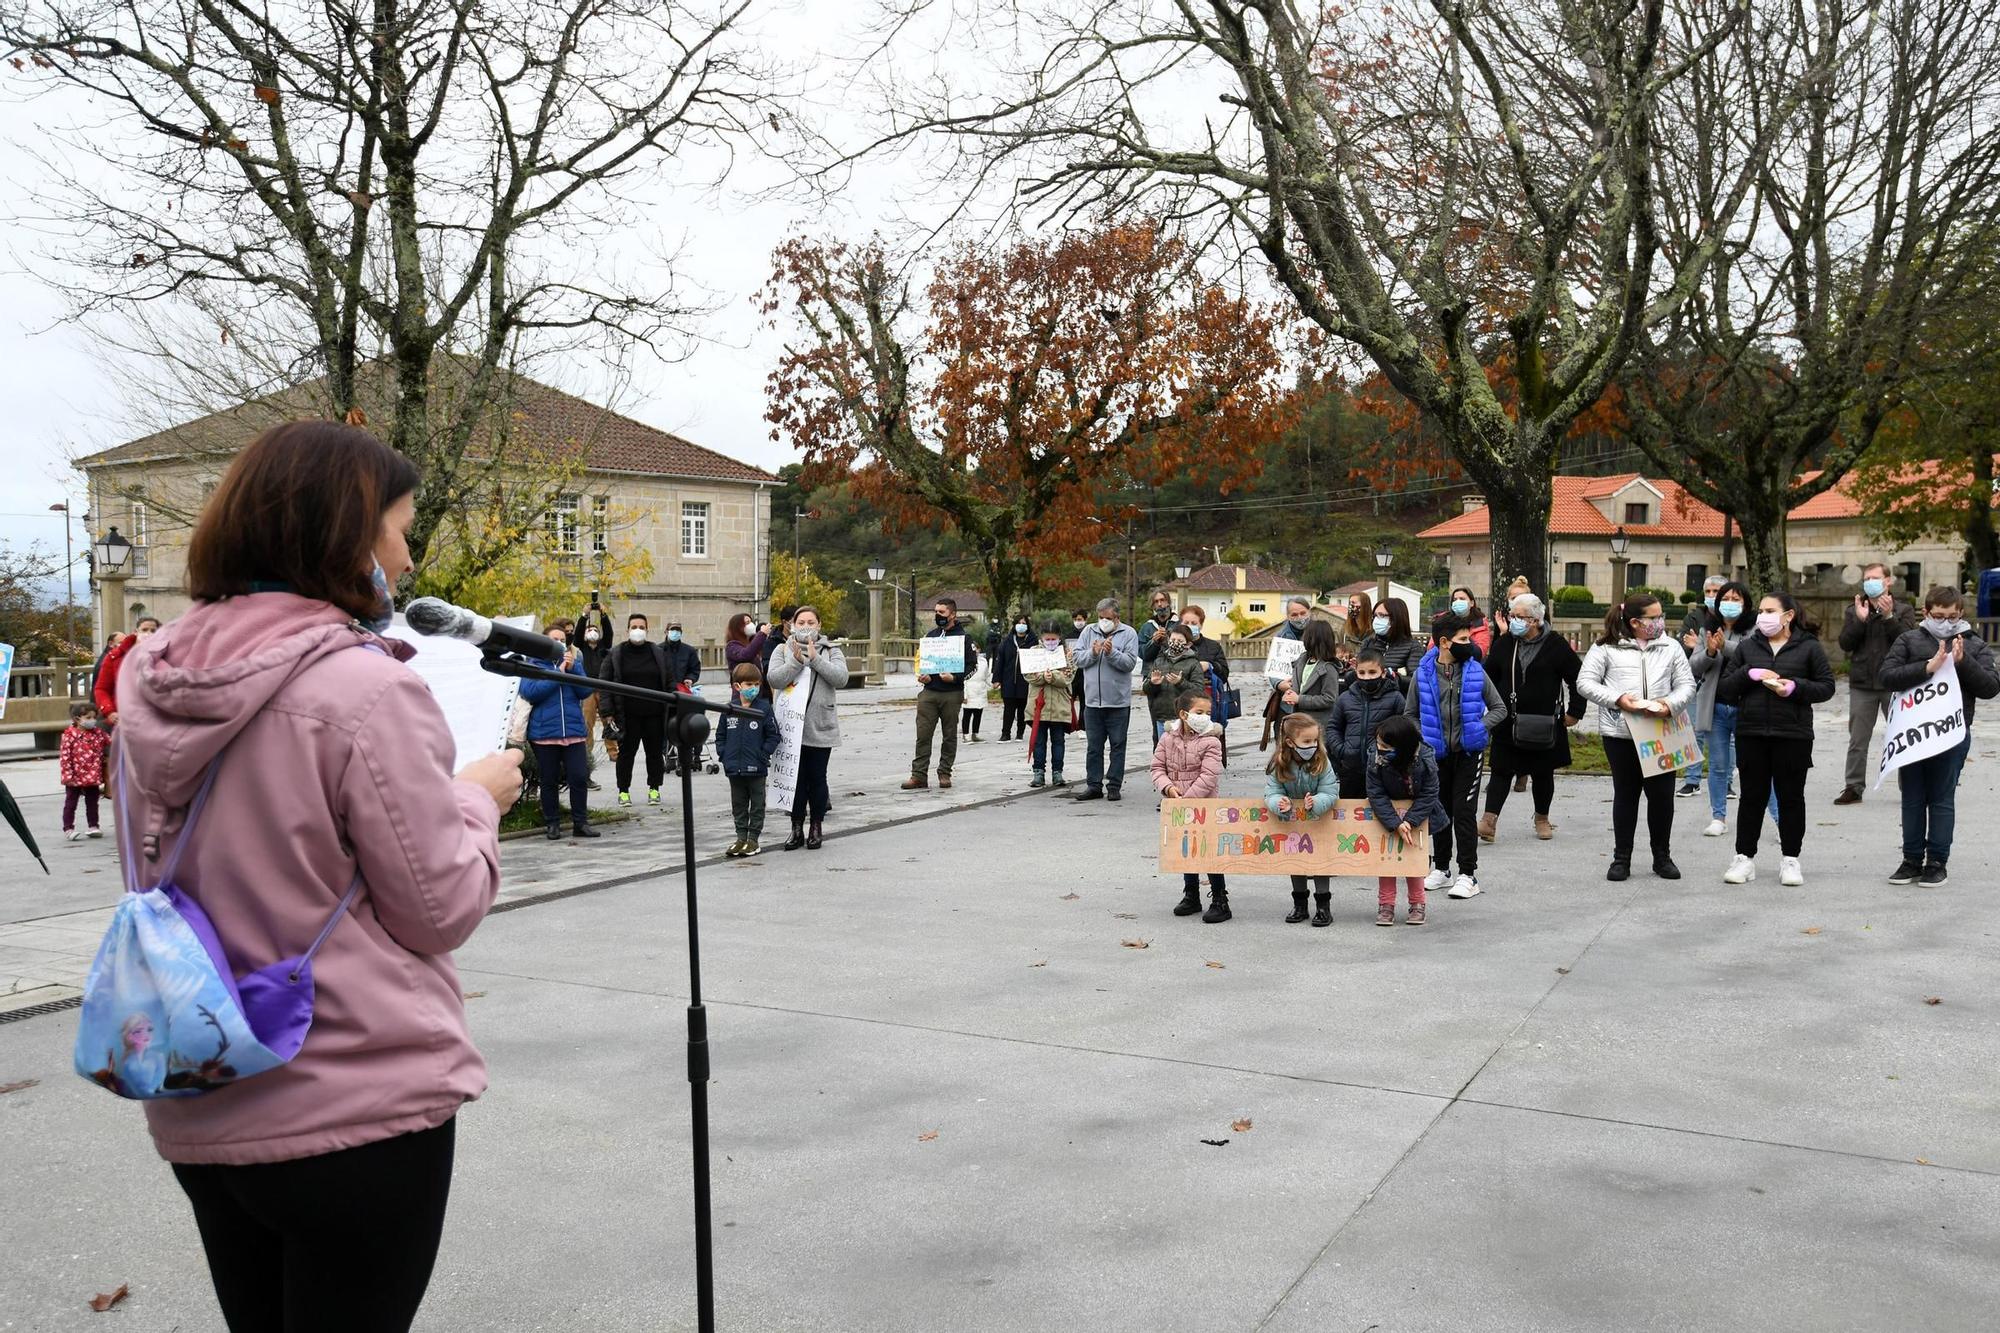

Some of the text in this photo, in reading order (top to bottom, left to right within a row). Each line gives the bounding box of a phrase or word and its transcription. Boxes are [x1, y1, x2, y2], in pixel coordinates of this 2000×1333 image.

[1900, 681, 1949, 712] NOSO
[776, 749, 798, 765] PERTE
[774, 763, 795, 777] NECE
[777, 794, 791, 806] XA
[1171, 806, 1207, 827] NON
[1214, 806, 1269, 825] SOMOS
[1332, 807, 1346, 821] DE
[1217, 829, 1314, 856] PEDIATRA
[1336, 833, 1370, 854] XA
